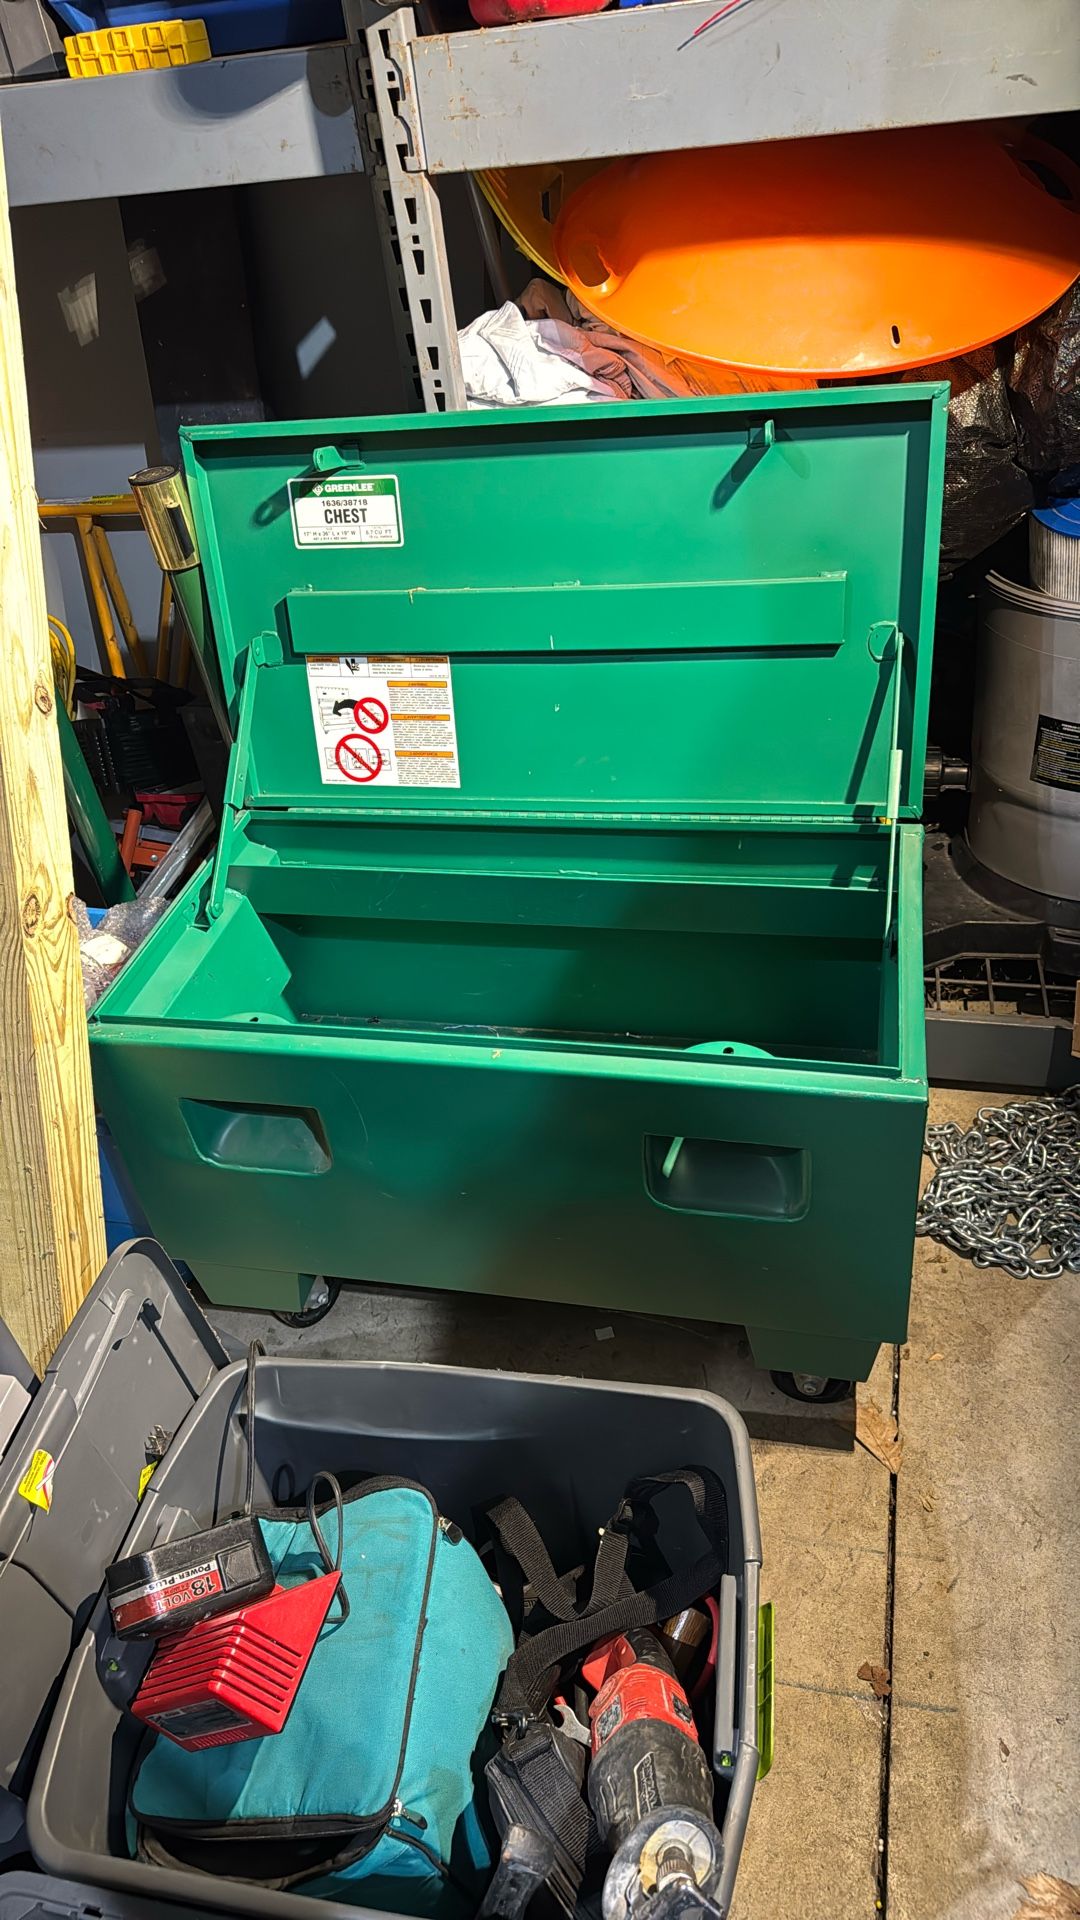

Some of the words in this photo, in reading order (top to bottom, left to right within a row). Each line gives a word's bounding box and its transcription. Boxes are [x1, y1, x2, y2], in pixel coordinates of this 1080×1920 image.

[325, 483, 374, 493] GREENLEE
[324, 508, 367, 524] CHEST
[191, 1576, 216, 1597] 18
[156, 1592, 191, 1610] VOLT
